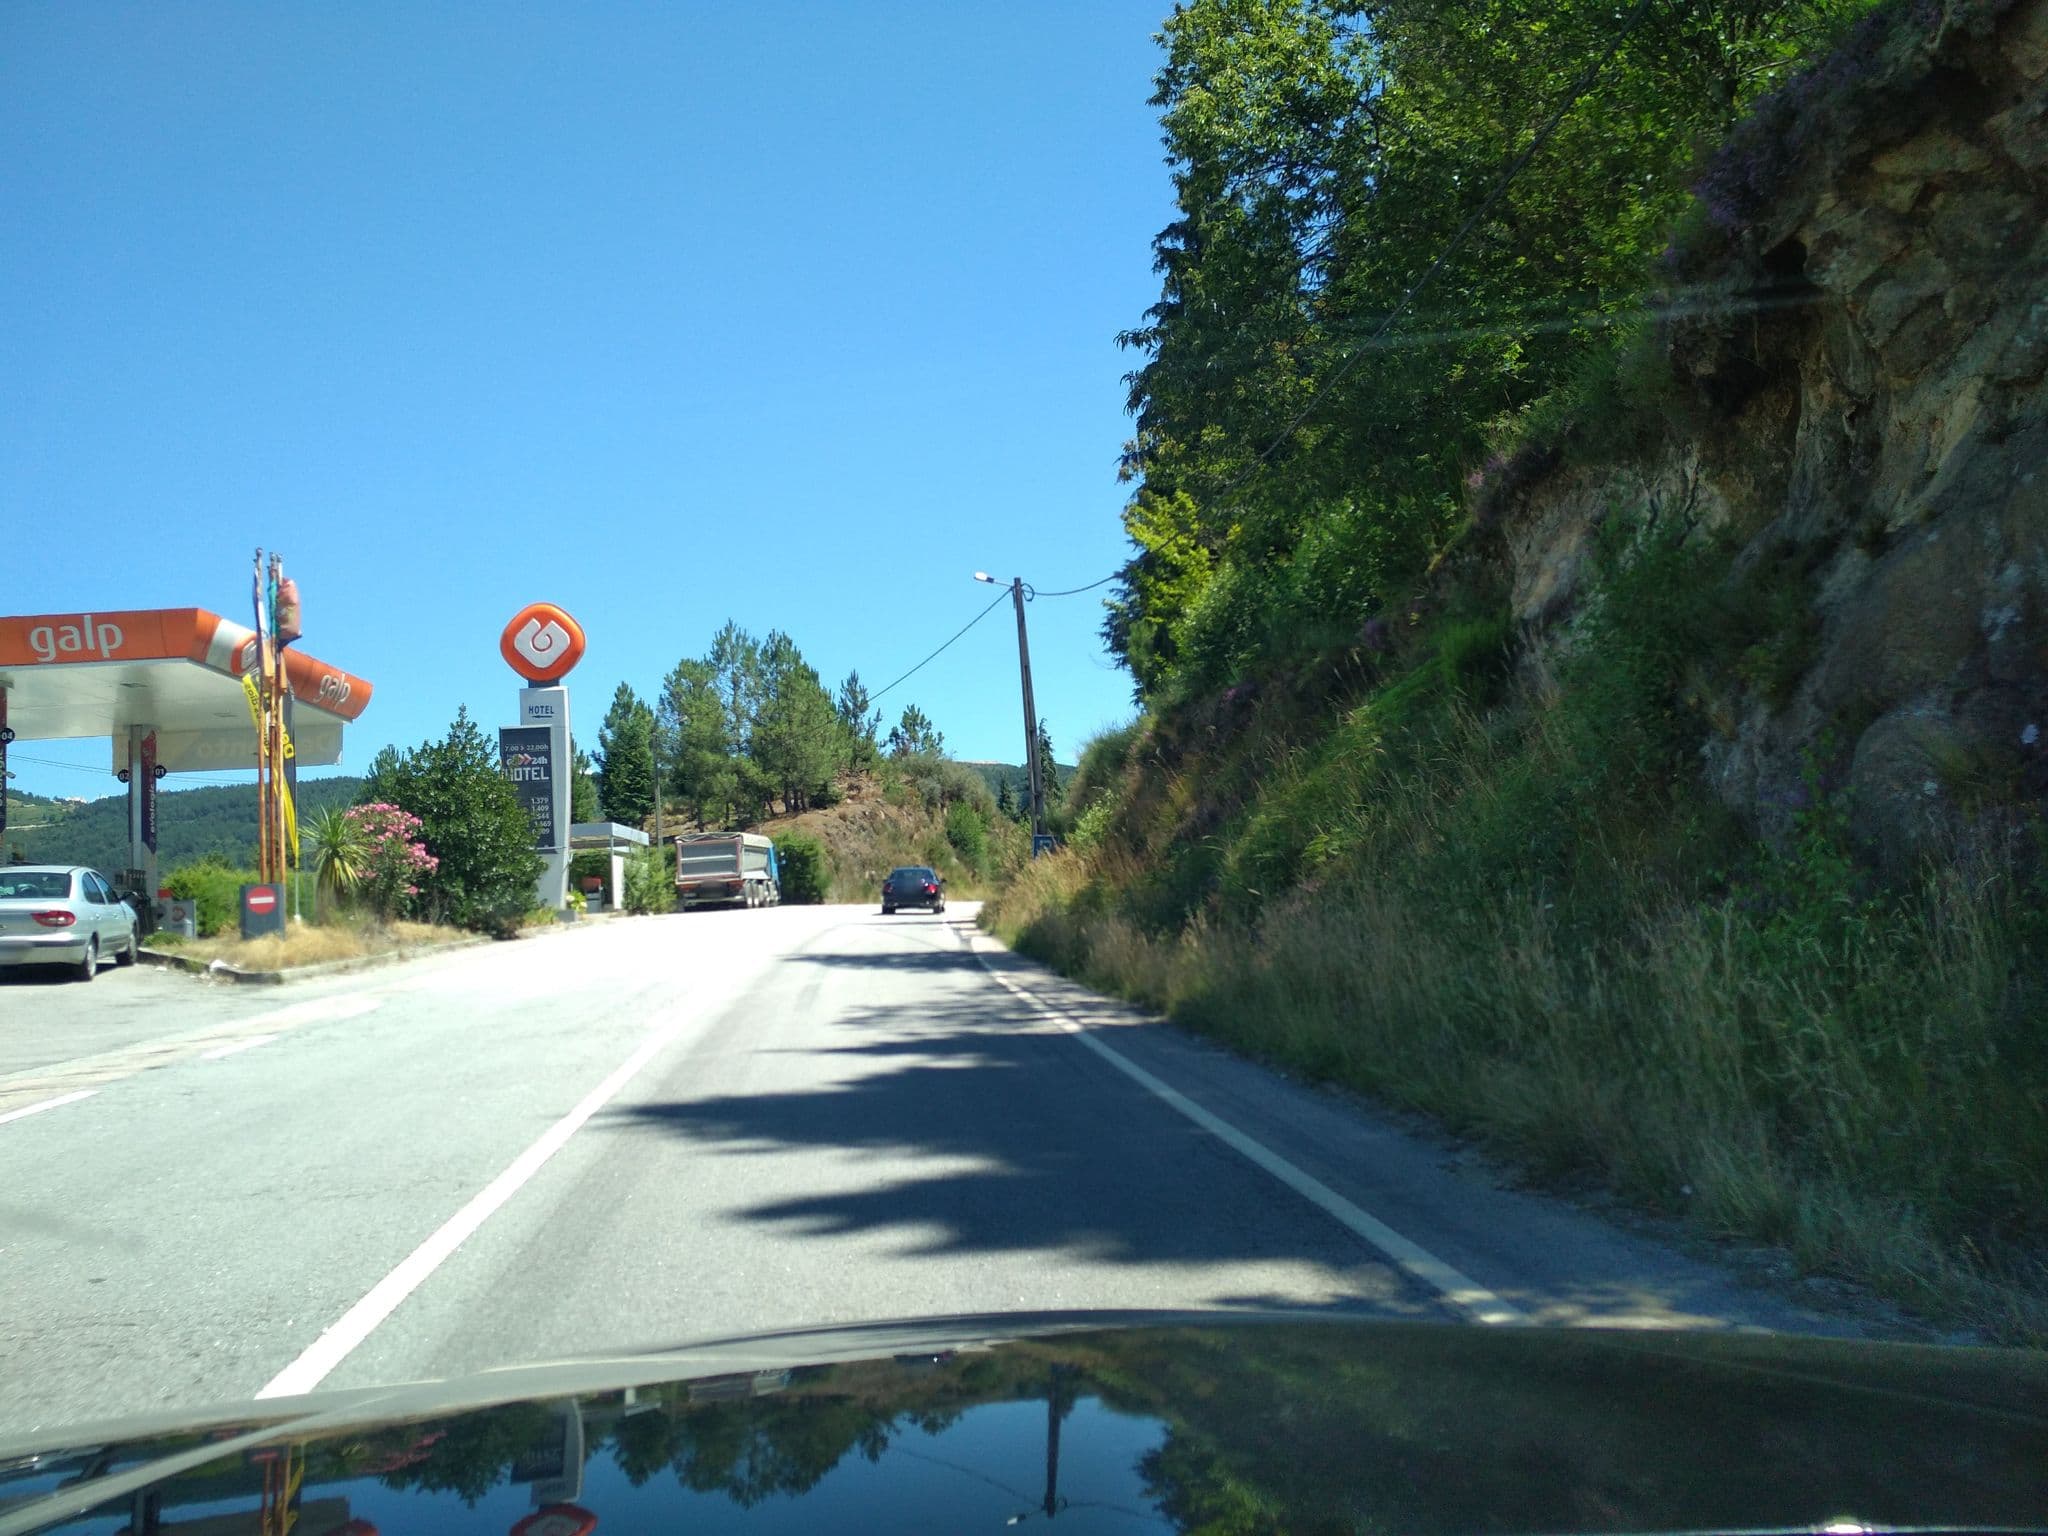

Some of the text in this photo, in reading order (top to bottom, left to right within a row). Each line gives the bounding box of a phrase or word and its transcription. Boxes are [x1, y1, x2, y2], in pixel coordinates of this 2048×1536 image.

[30, 615, 123, 662] galp
[313, 673, 352, 709] galp
[528, 705, 555, 714] HOTEL
[1, 731, 13, 741] 04
[531, 755, 548, 765] 24h
[155, 768, 165, 776] 01
